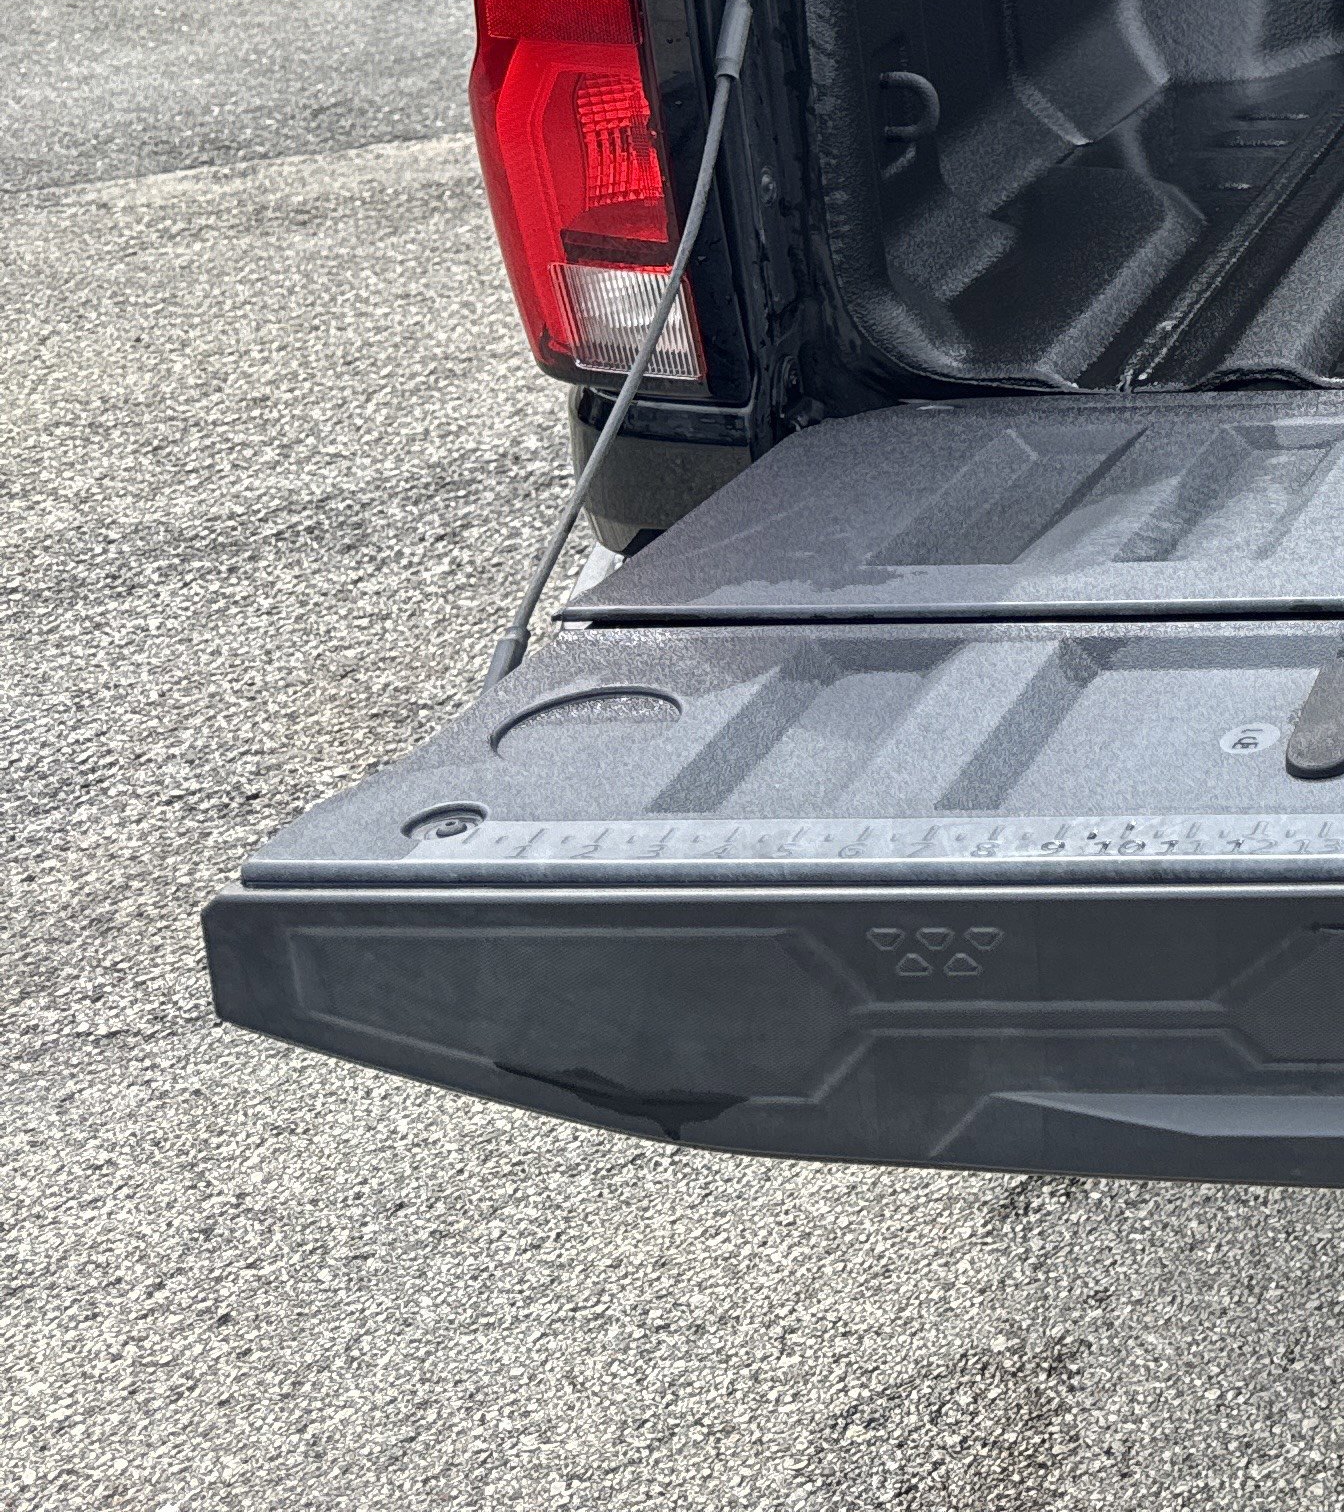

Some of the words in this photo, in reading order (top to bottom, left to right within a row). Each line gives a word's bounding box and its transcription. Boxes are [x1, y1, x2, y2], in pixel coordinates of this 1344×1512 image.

[500, 845, 527, 857] 1
[570, 845, 601, 858] 2
[636, 845, 664, 857] 3
[704, 844, 734, 857] 4
[771, 843, 797, 857] 5
[838, 842, 865, 858] 6
[907, 842, 934, 857] 7
[970, 841, 1001, 857] 8
[1041, 840, 1065, 854] 9
[1093, 839, 1146, 854] 10
[1226, 838, 1277, 853] 12
[1298, 838, 1344, 853] 13
